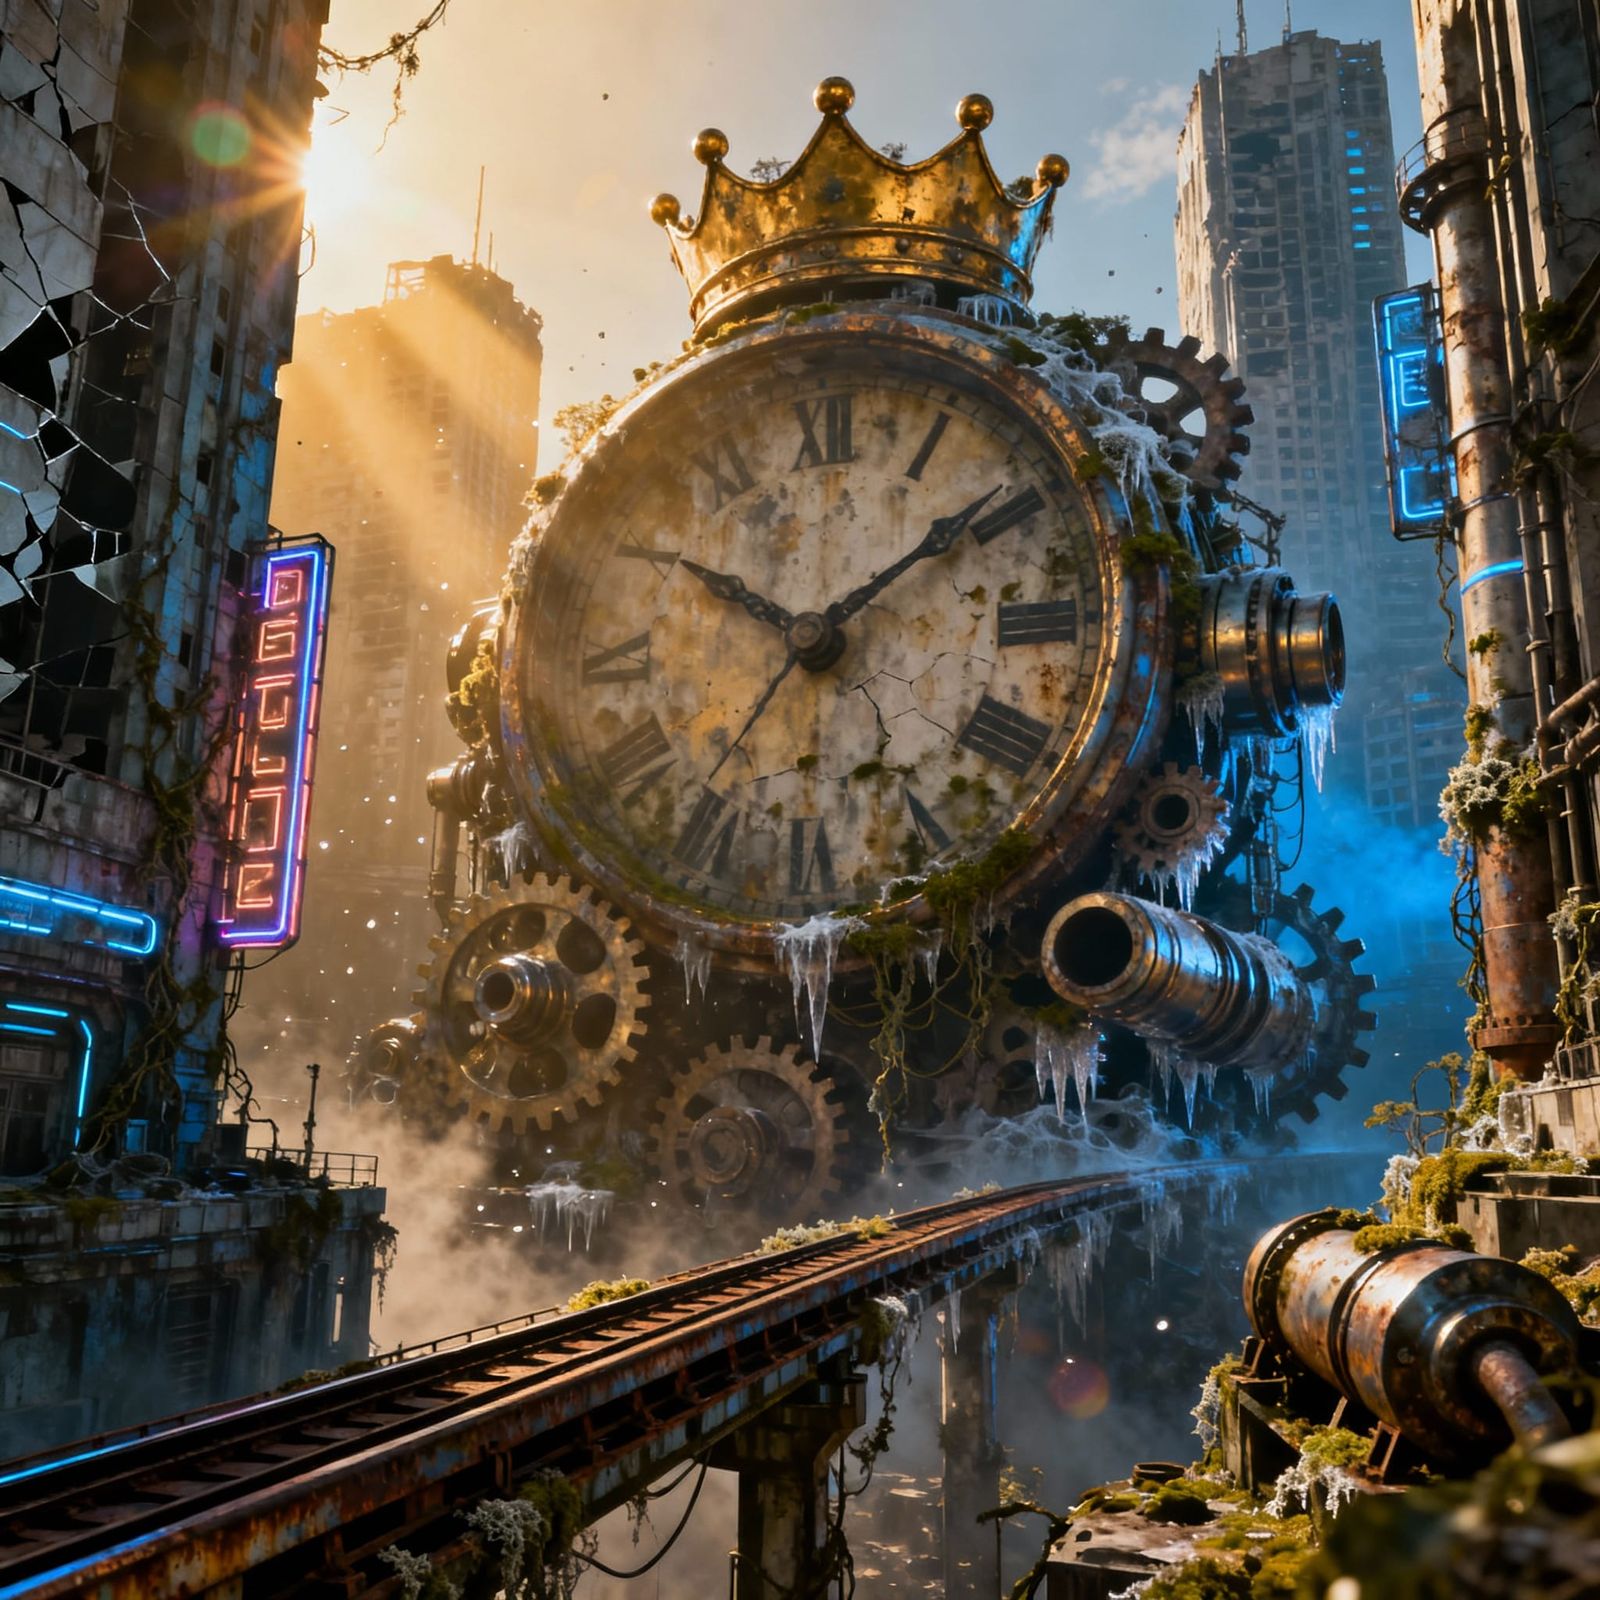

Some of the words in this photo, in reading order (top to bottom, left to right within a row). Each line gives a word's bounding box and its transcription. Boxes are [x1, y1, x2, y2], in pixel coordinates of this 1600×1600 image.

[791, 396, 860, 472] XII
[905, 411, 951, 481] I
[690, 431, 759, 514] XI
[970, 484, 1046, 546] II
[613, 528, 681, 580] X
[998, 598, 1076, 648] III
[583, 632, 650, 685] IX
[955, 692, 1054, 778] IIII
[788, 817, 837, 895] VI
